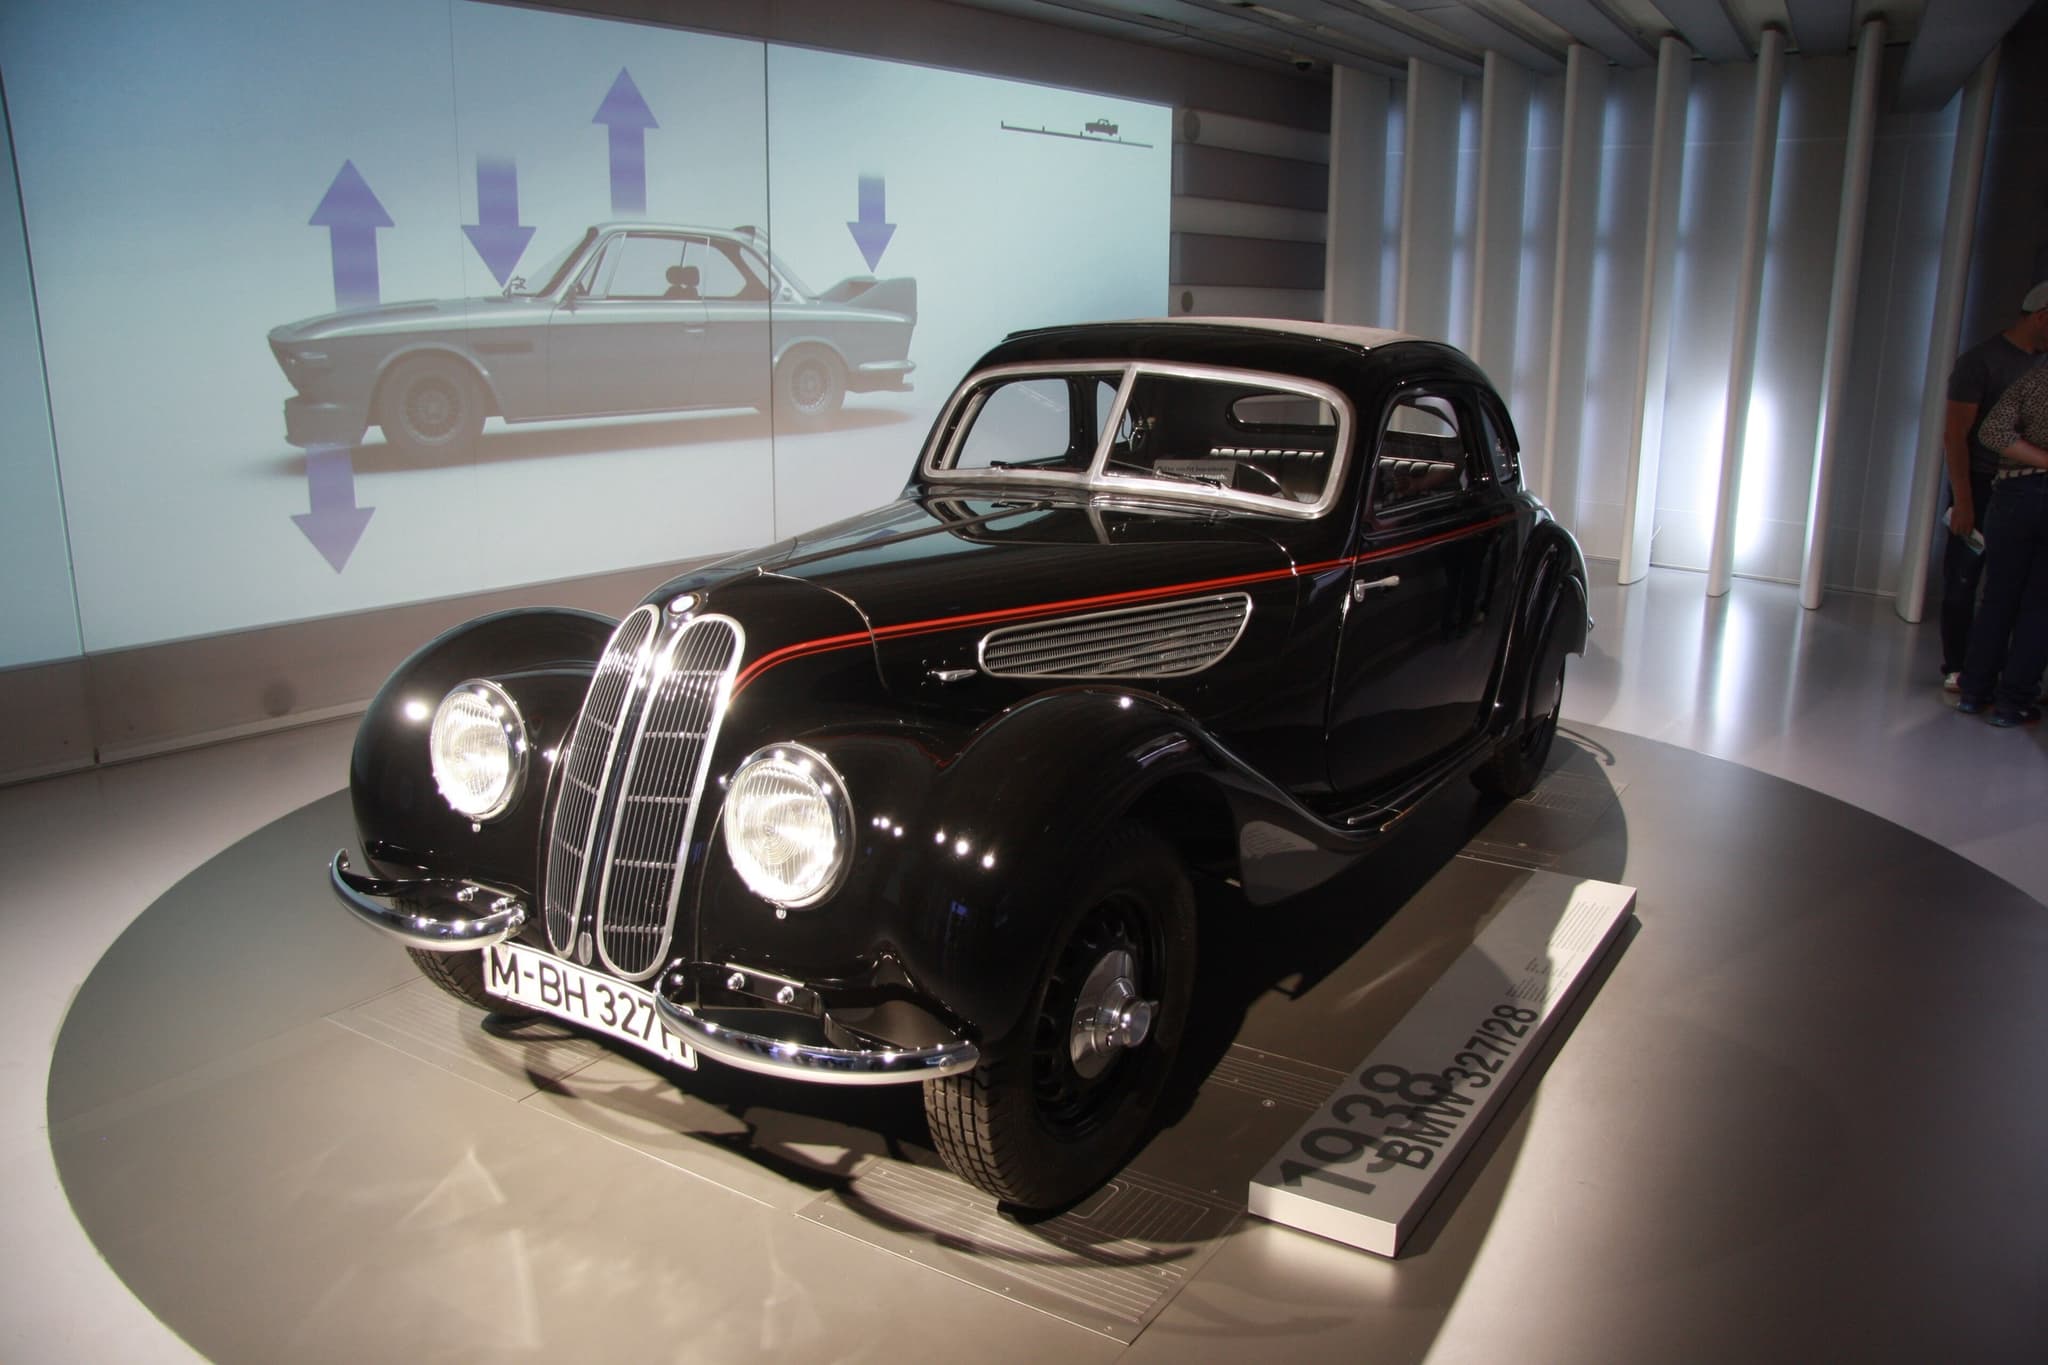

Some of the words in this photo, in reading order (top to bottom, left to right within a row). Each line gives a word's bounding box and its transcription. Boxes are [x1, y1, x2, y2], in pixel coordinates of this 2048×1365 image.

[491, 946, 589, 1018] M-BH
[1279, 1064, 1454, 1195] 1938
[1374, 1086, 1475, 1170] BMW
[1441, 1004, 1538, 1089] 327/28
